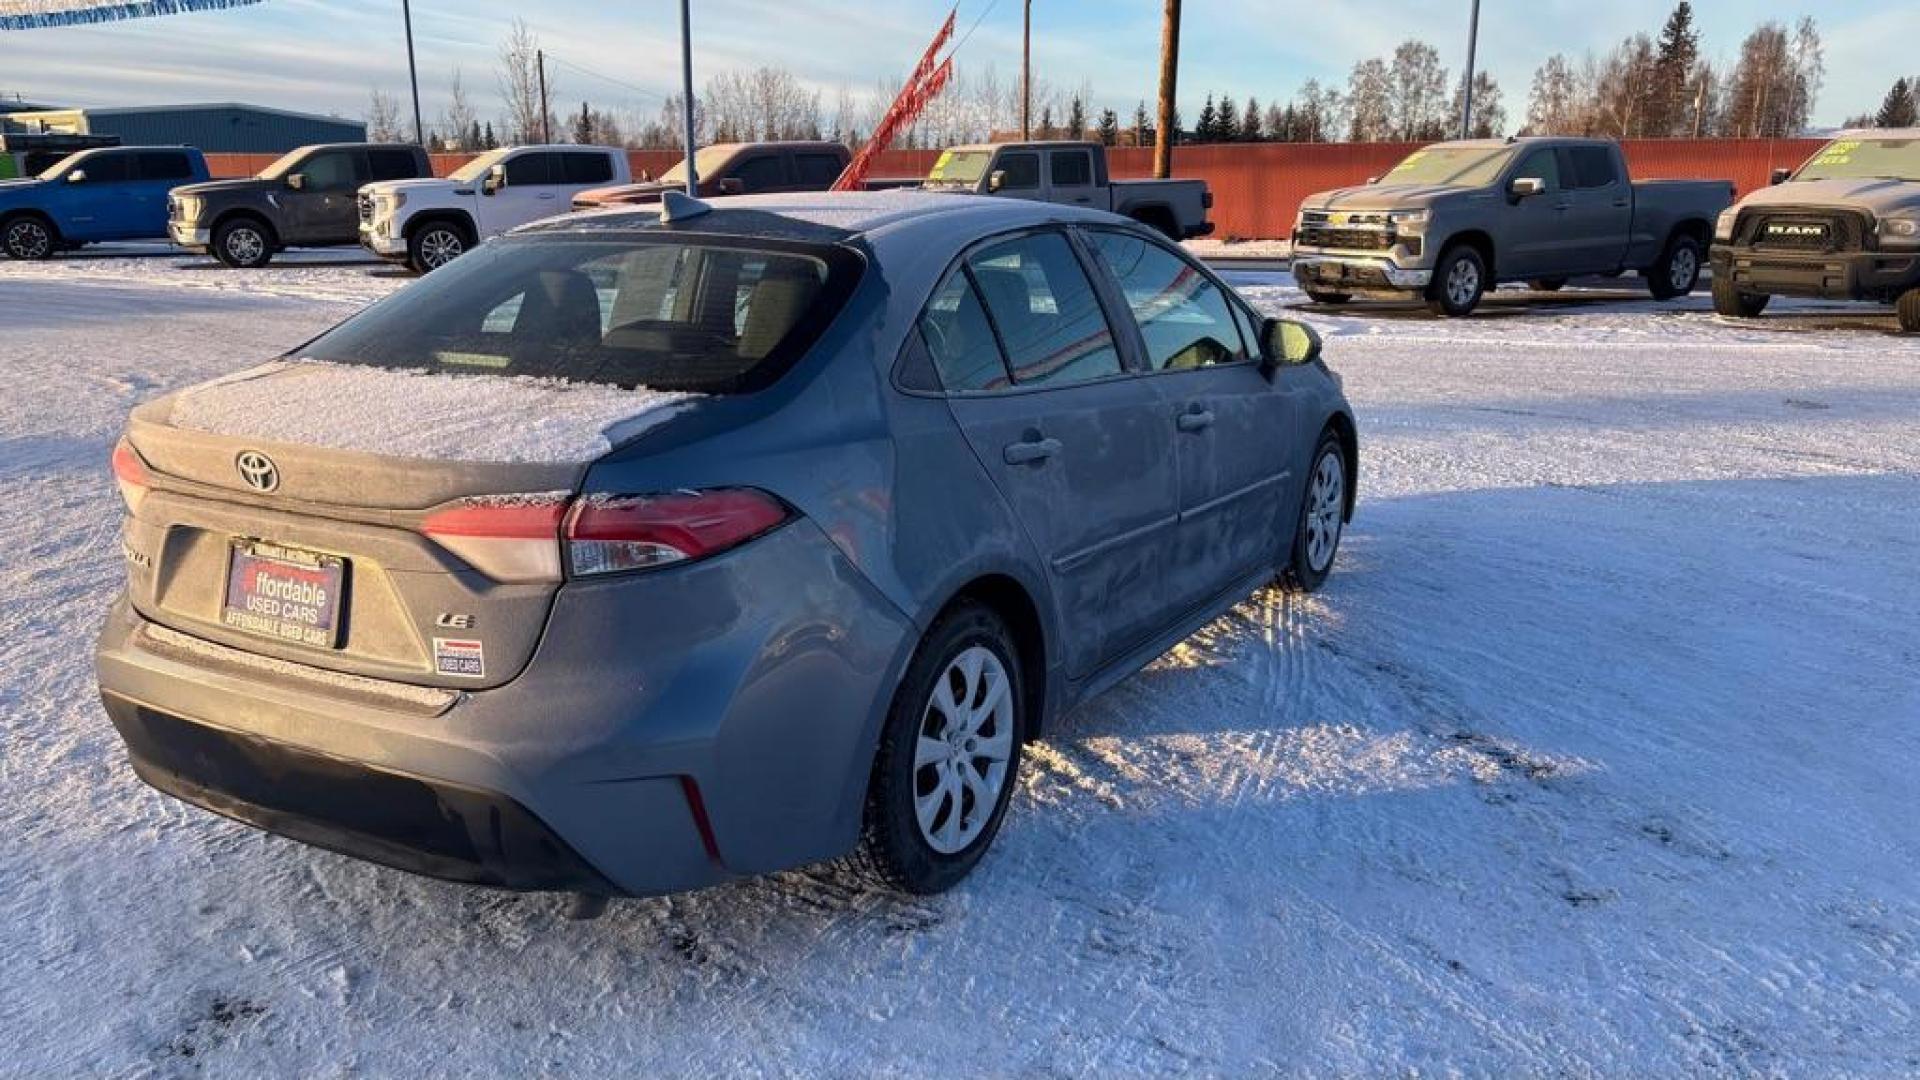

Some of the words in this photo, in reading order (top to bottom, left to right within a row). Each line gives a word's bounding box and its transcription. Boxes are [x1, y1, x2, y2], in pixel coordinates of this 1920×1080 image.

[1768, 226, 1822, 235] RAM
[246, 594, 280, 616] USED
[282, 602, 318, 625] CARS
[436, 613, 474, 628] LE
